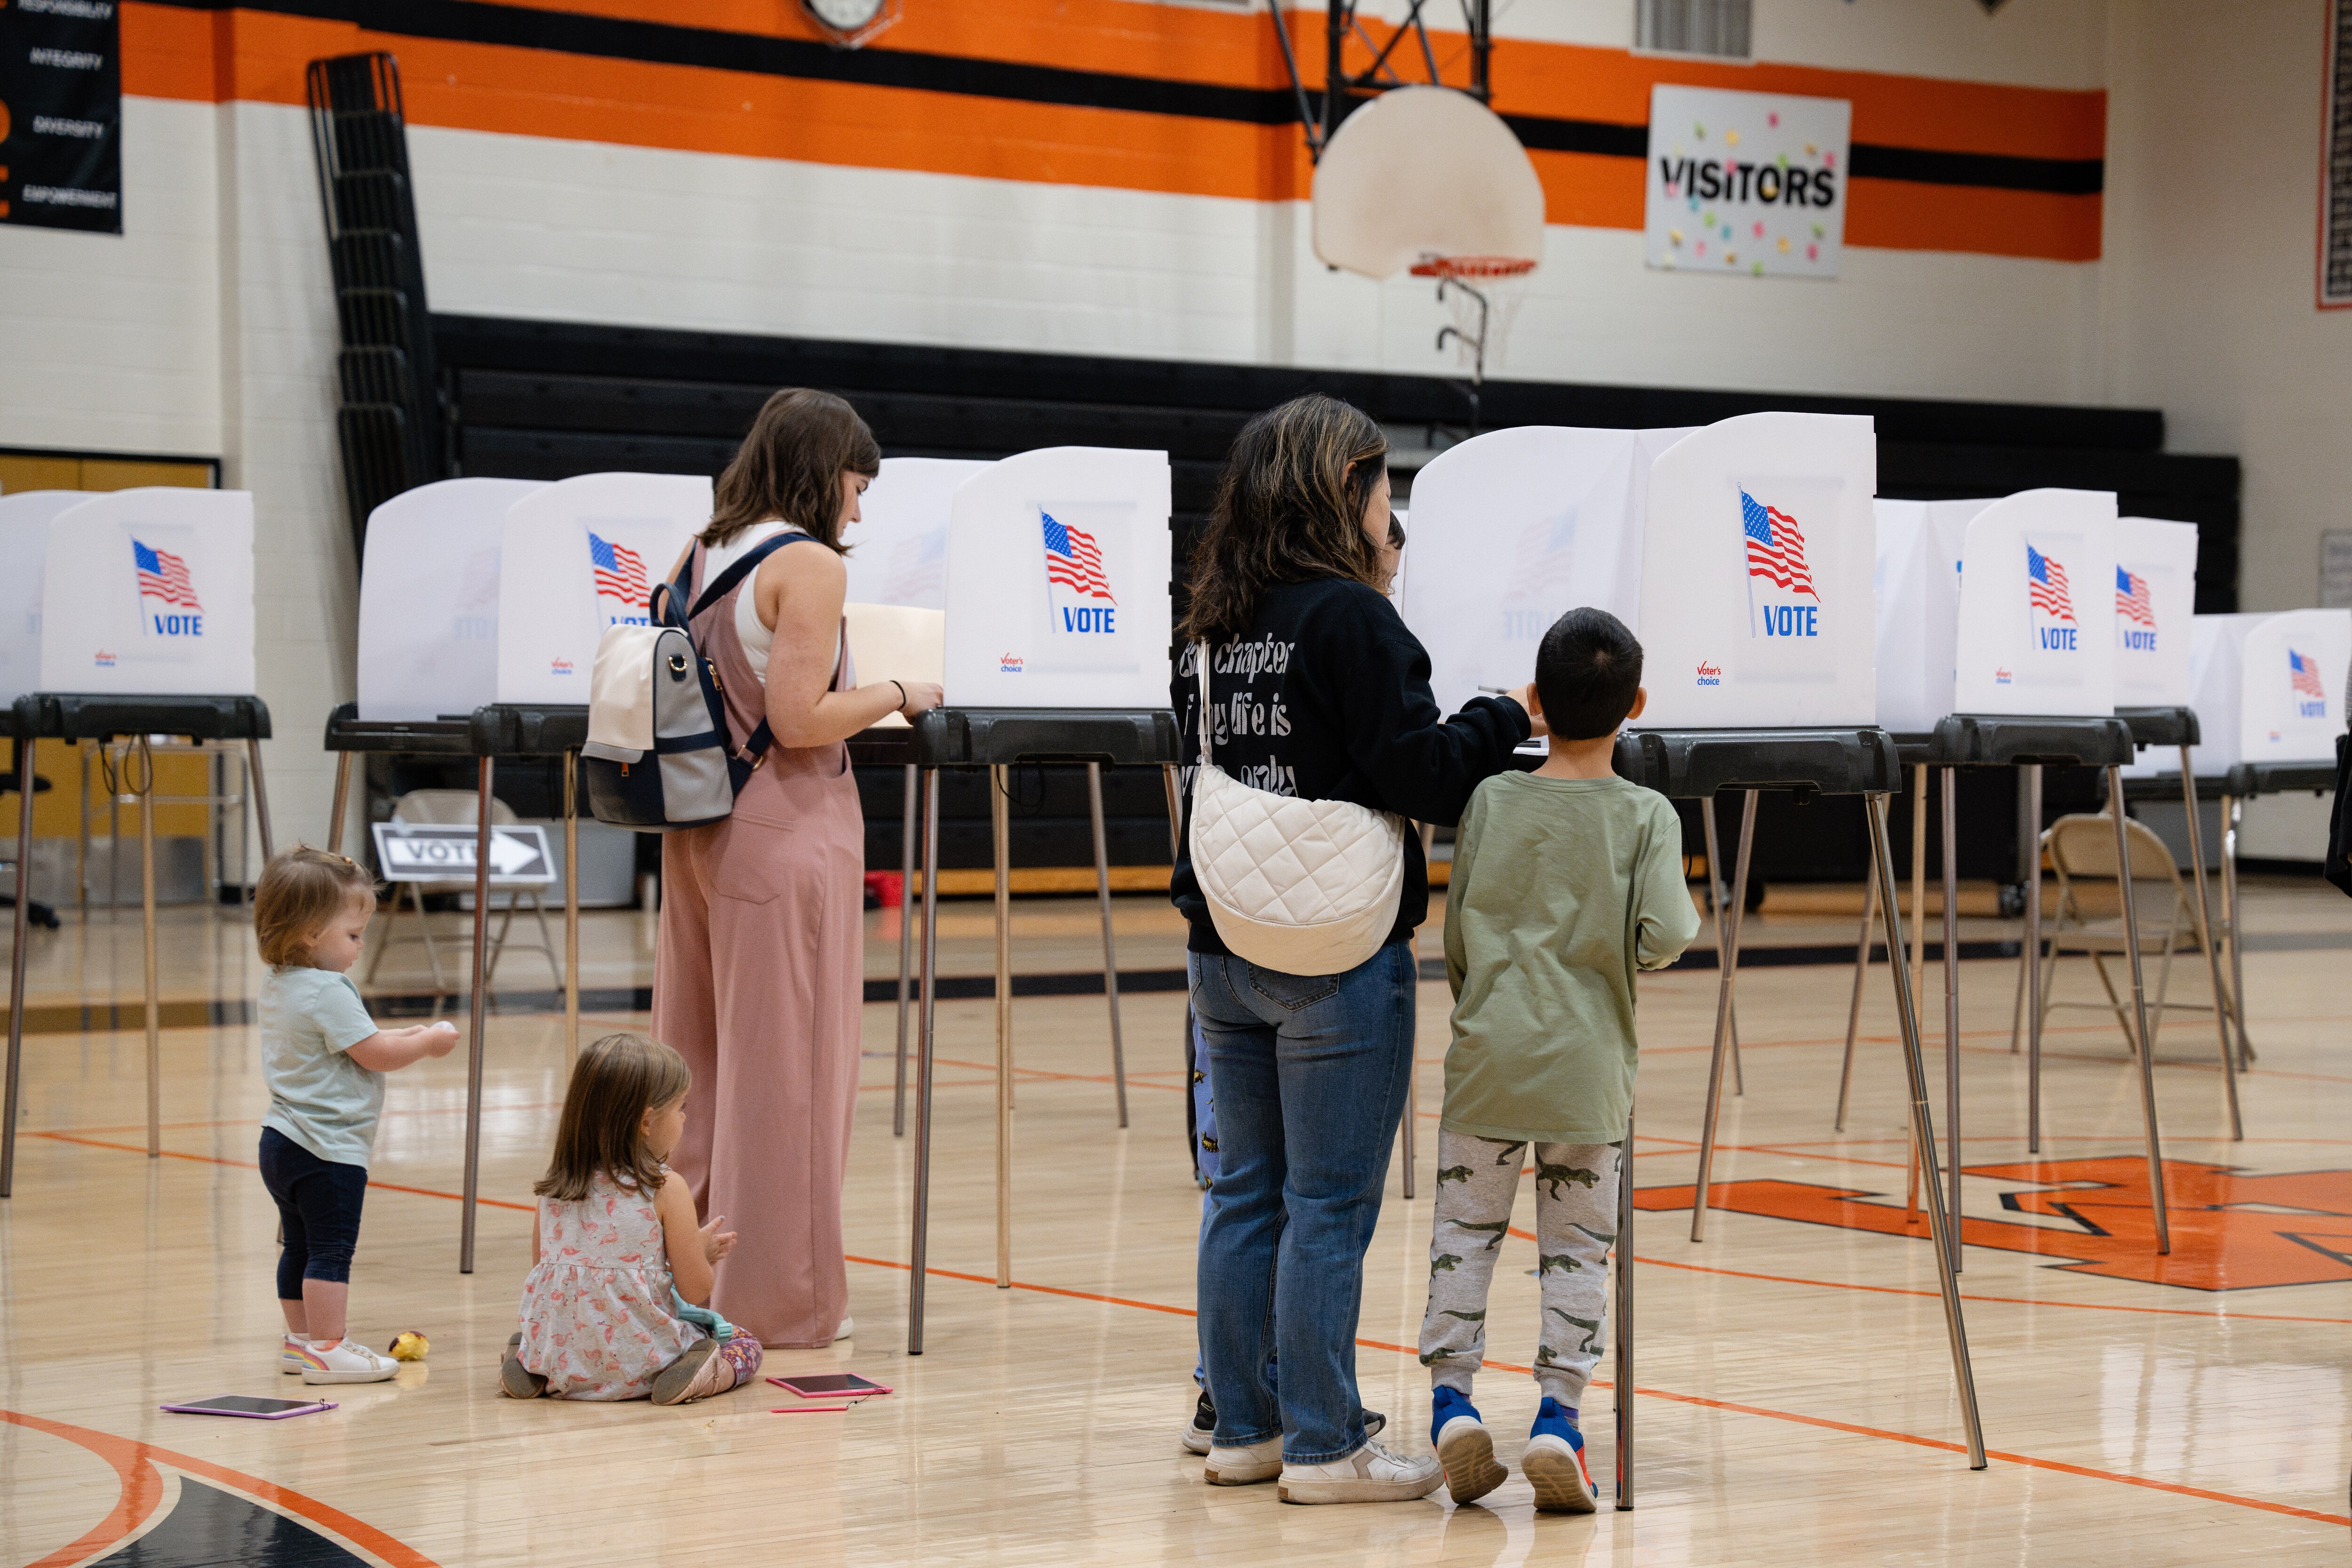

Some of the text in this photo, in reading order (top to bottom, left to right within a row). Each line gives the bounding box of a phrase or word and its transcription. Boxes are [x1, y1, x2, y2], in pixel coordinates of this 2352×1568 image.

[30, 47, 103, 71] INTEGRITY
[33, 115, 103, 139] DIVERSITY
[1661, 156, 1835, 209] VISITORS
[23, 184, 117, 210] EMPOWERMENT
[154, 614, 203, 635] VOTE
[1064, 607, 1115, 633] VOTE
[1764, 605, 1818, 636] VOTE
[2041, 627, 2077, 650] VOTE
[2124, 630, 2157, 651] VOTE
[1001, 652, 1023, 665] Voter's
[1215, 633, 1295, 683] chapter
[1697, 660, 1721, 675] Voter's
[1697, 676, 1719, 686] choice
[1231, 692, 1265, 736] life
[1271, 692, 1291, 736] is
[1240, 755, 1299, 798] only
